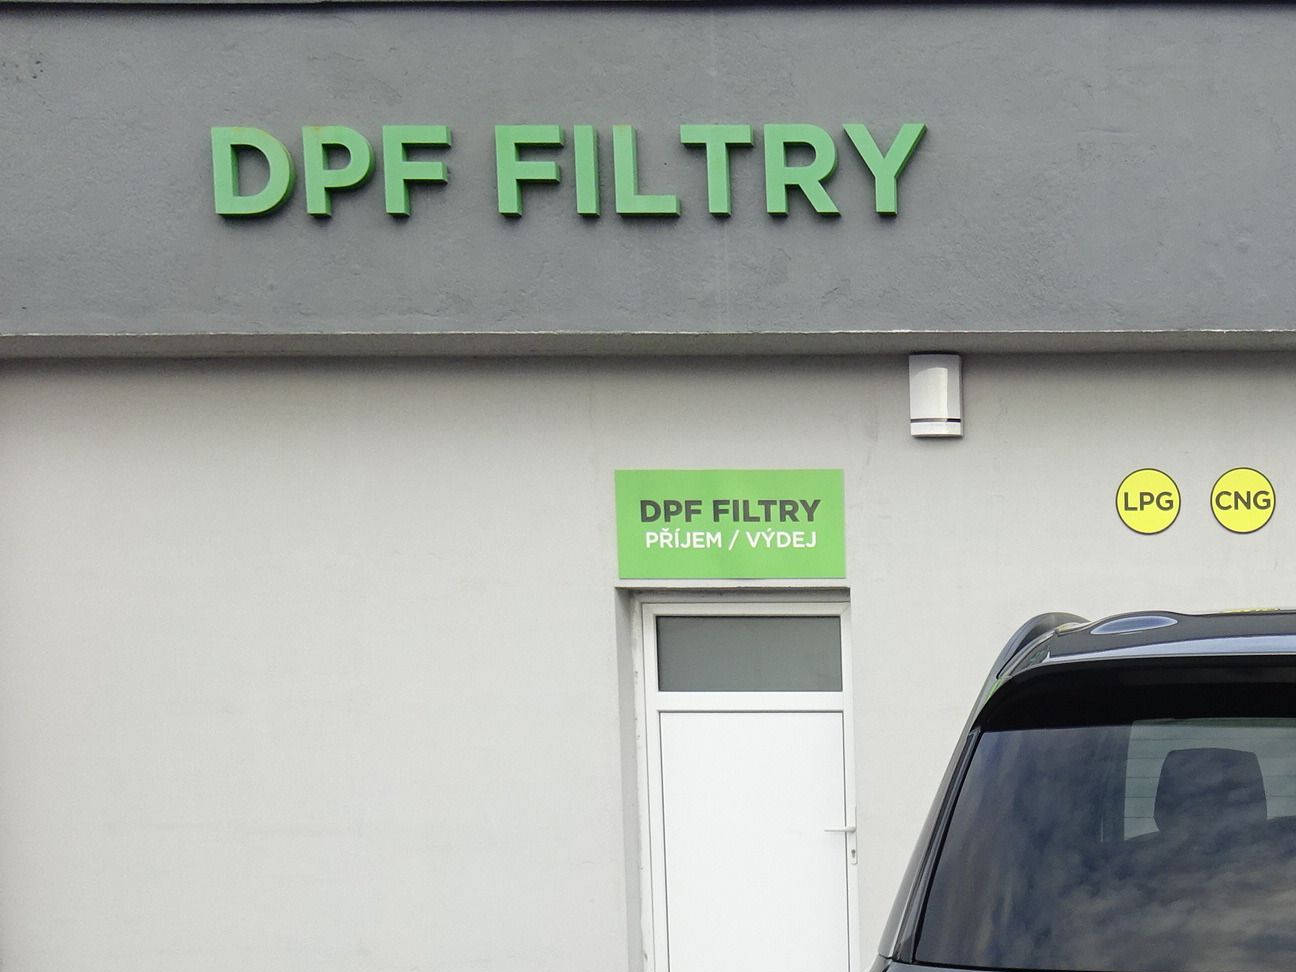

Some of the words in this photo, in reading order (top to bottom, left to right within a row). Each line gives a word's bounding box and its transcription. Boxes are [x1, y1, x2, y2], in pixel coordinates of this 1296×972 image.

[210, 124, 451, 217] DPF
[494, 121, 927, 217] FILTRY
[640, 499, 702, 523] DPF
[712, 499, 821, 523] FILTRY
[1123, 491, 1174, 512] LPG
[1215, 490, 1271, 511] CNG
[645, 528, 722, 549] PŘÍJEM
[728, 529, 740, 551] /
[746, 528, 817, 549] VÝDEJ
